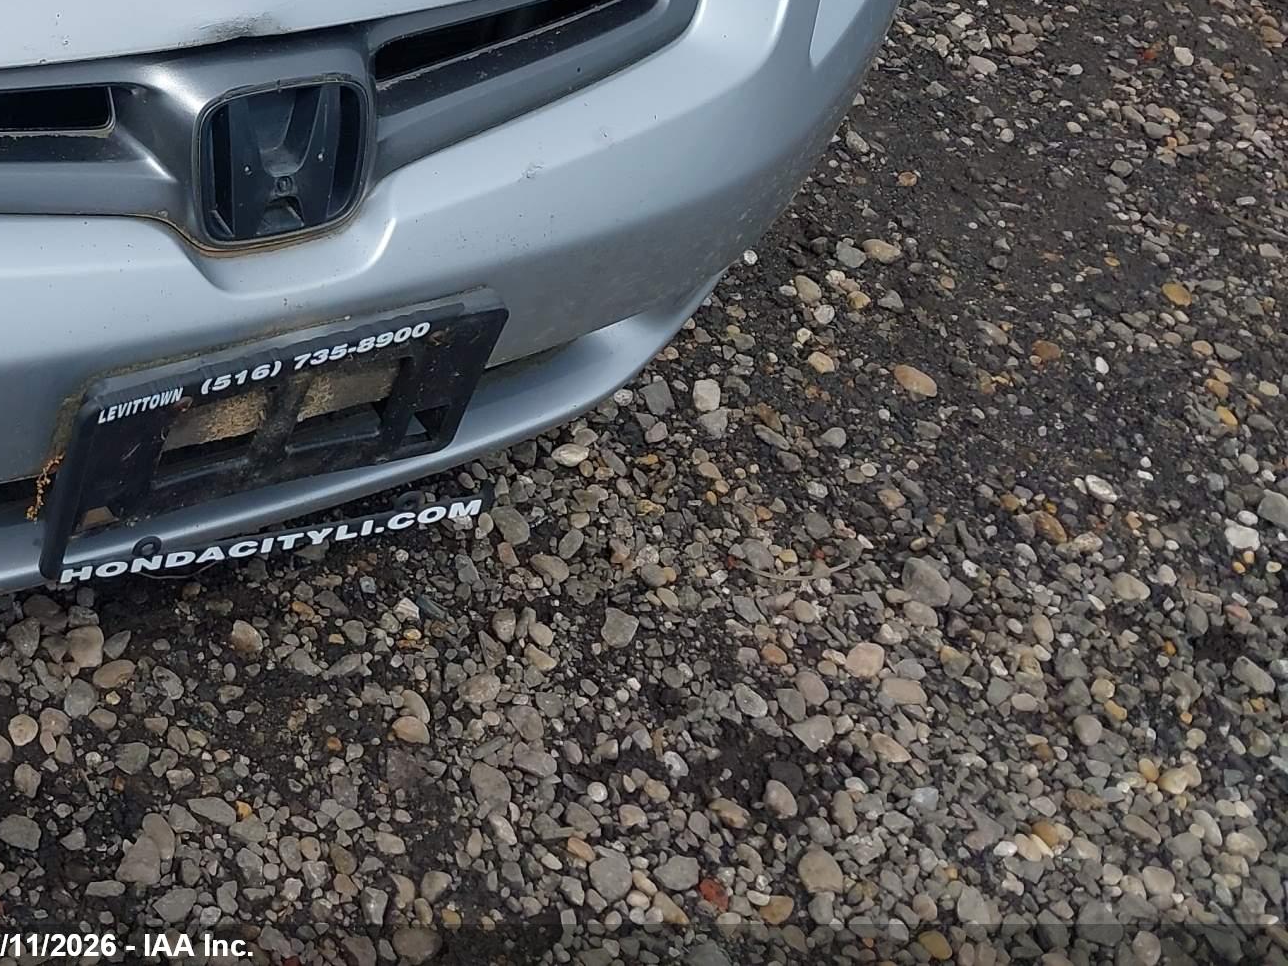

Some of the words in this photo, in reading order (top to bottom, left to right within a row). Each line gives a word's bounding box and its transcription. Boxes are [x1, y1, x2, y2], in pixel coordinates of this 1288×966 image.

[97, 386, 184, 424] LEVITTOWN
[200, 360, 282, 395] (516)
[293, 321, 431, 371] 735-8900
[59, 499, 483, 584] HONDACITYLI.COM
